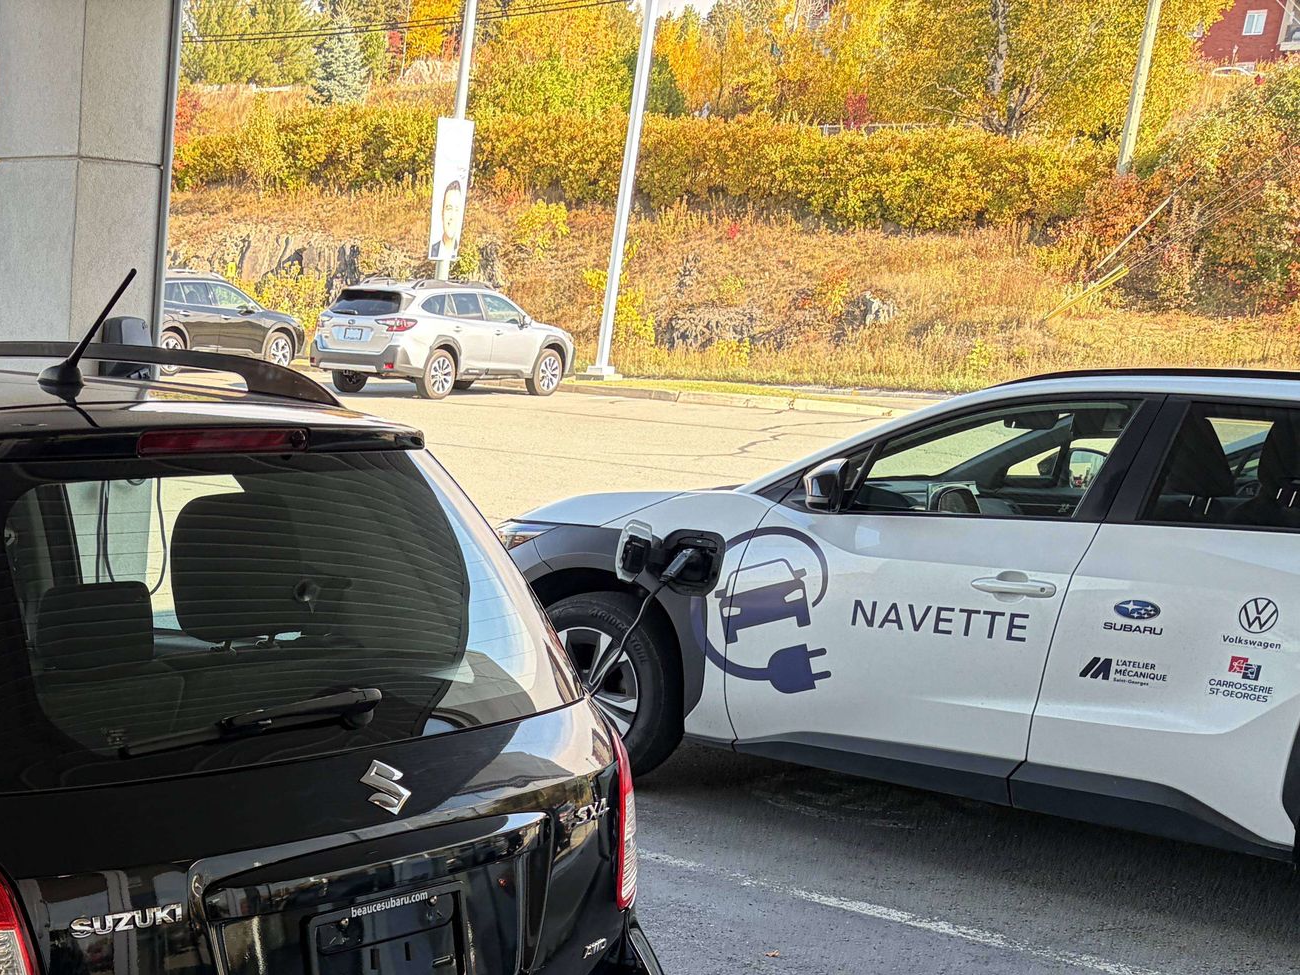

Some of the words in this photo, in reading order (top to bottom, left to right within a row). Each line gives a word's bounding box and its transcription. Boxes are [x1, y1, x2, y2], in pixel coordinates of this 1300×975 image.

[851, 599, 1030, 643] NAVETTE
[1103, 621, 1163, 636] SUBARU
[588, 606, 648, 666] BRIDGETONE
[1222, 634, 1281, 649] Volkswagen
[1116, 658, 1156, 671] L'ATELIER
[1114, 668, 1167, 682] MÉCANIQUE
[1208, 678, 1273, 695] CARROSSERIE
[1209, 687, 1268, 703] ST-GEORGES
[576, 797, 610, 825] SX4
[350, 890, 429, 918] beaucesubaru.com
[70, 902, 183, 939] SUZUKI
